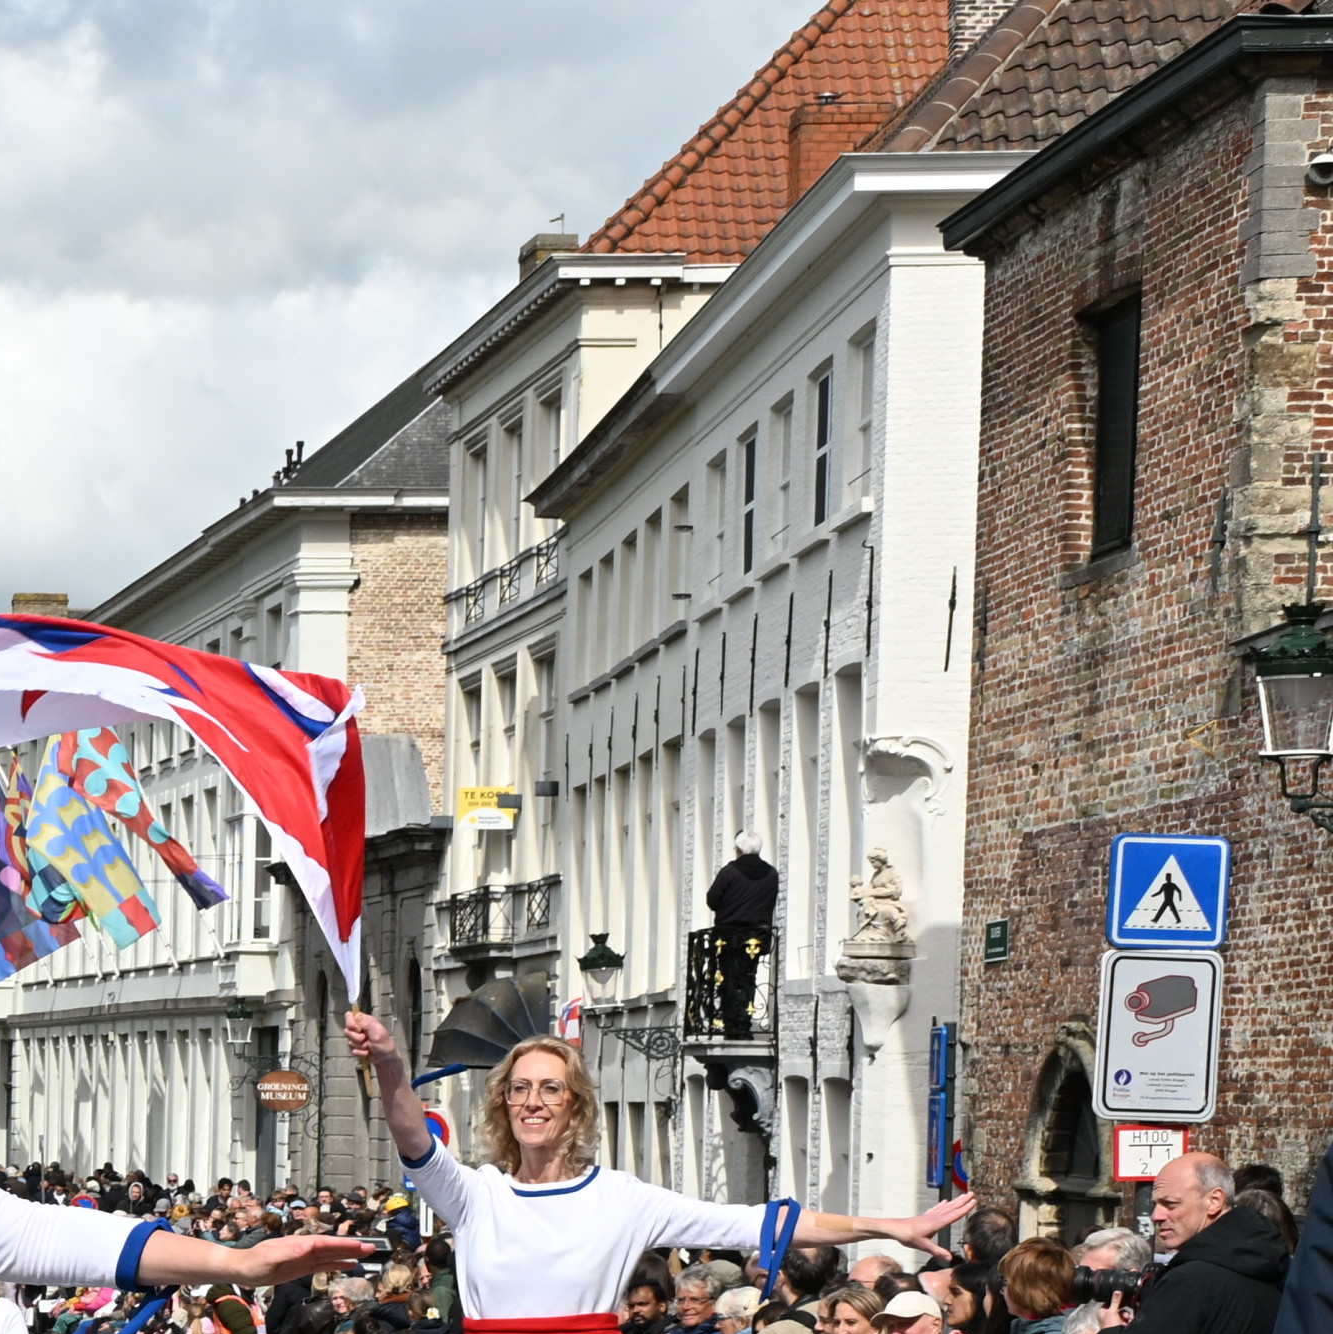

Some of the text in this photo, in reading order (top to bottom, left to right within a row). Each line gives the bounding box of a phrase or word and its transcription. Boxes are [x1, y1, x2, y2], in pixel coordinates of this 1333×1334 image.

[464, 791, 476, 799] TE
[256, 1082, 310, 1091] GROENINGE
[260, 1091, 307, 1100] MUSEUM
[1132, 1130, 1169, 1143] H100
